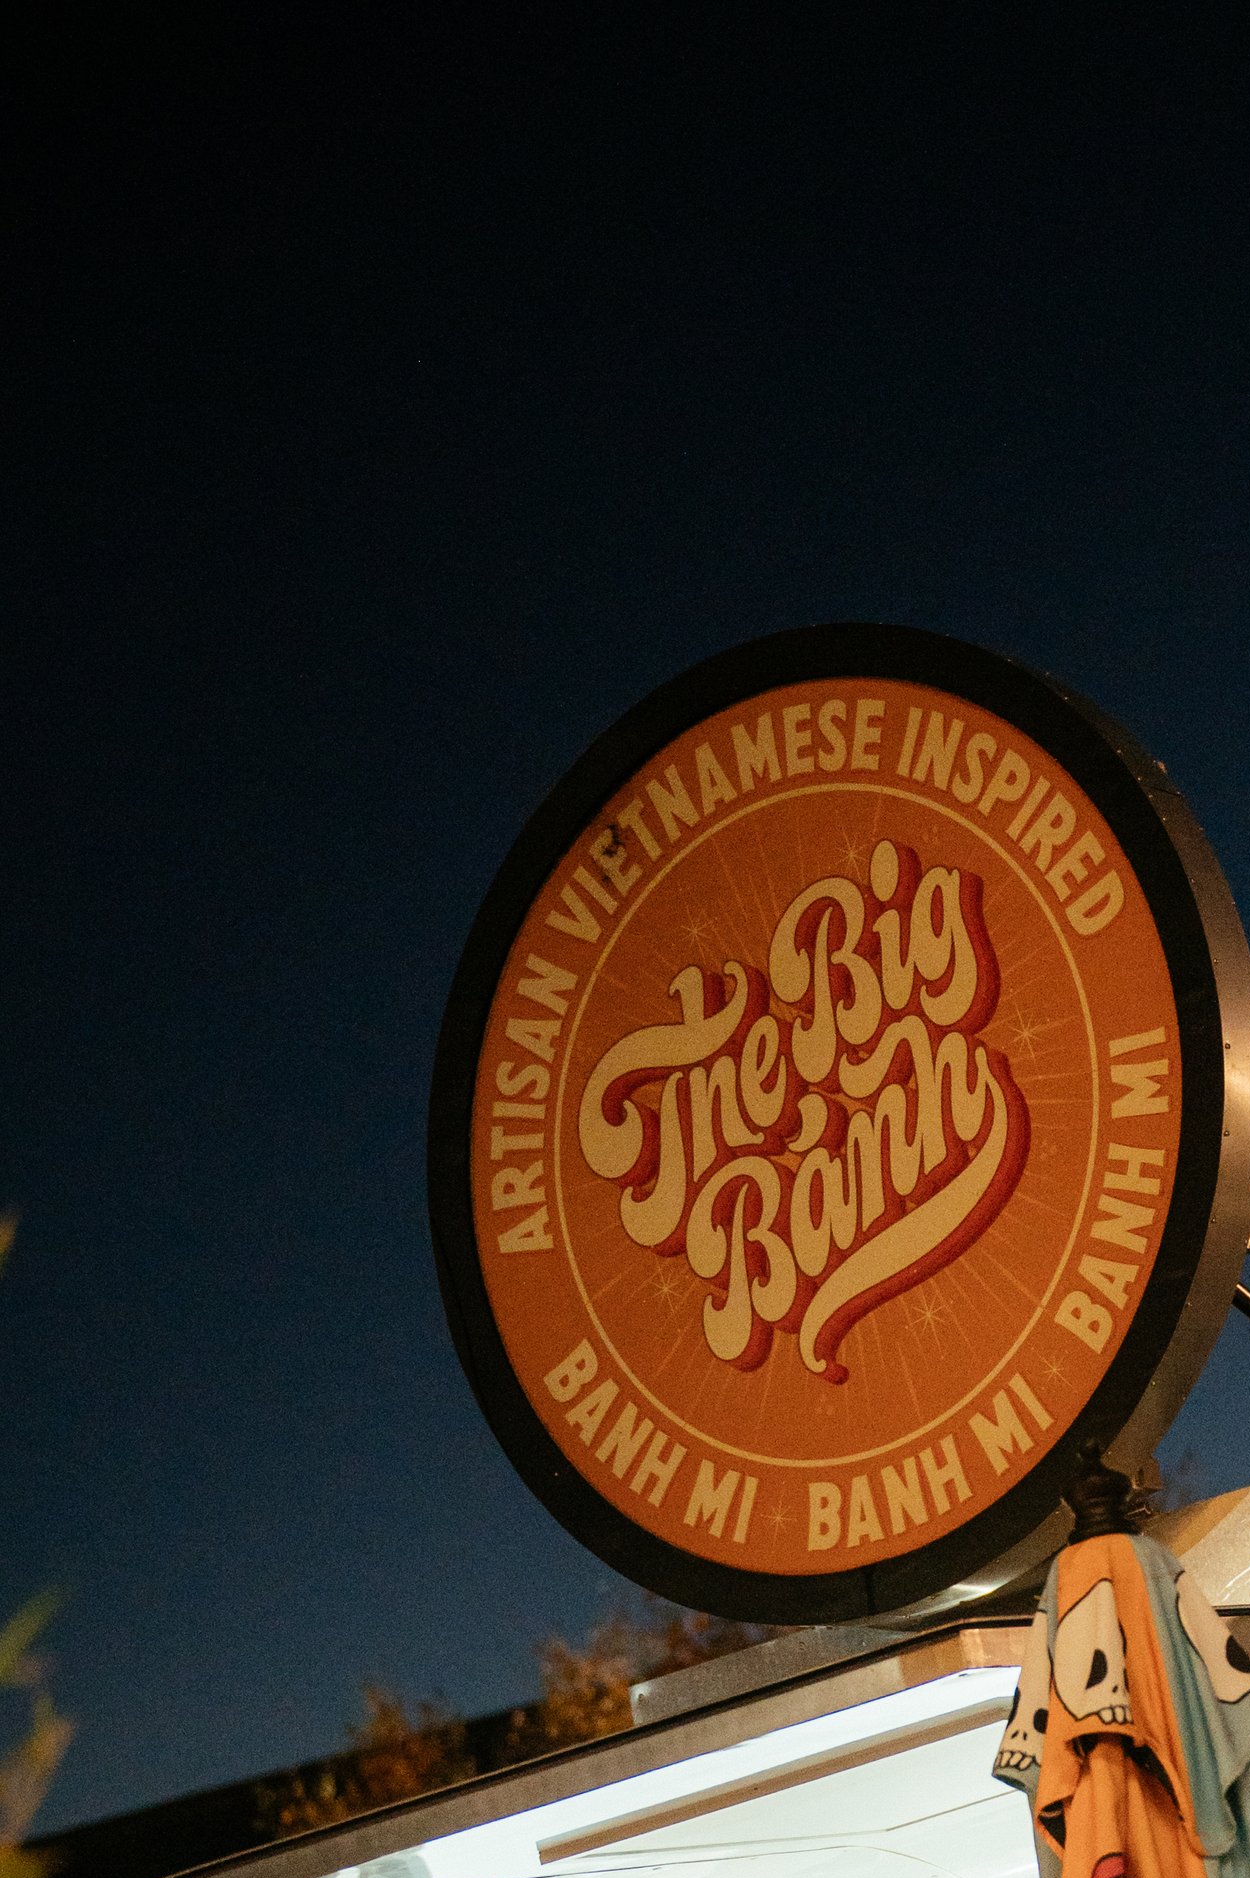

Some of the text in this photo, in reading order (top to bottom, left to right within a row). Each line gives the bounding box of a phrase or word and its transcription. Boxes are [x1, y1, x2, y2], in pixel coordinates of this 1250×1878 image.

[490, 698, 1125, 1254] ARTISAN VIETNAMESE INSPIRED
[579, 839, 982, 1247] The Big
[1054, 1026, 1170, 1355] BANH MI
[543, 1340, 759, 1544] BANH MI
[808, 1373, 1055, 1552] BANH MI
